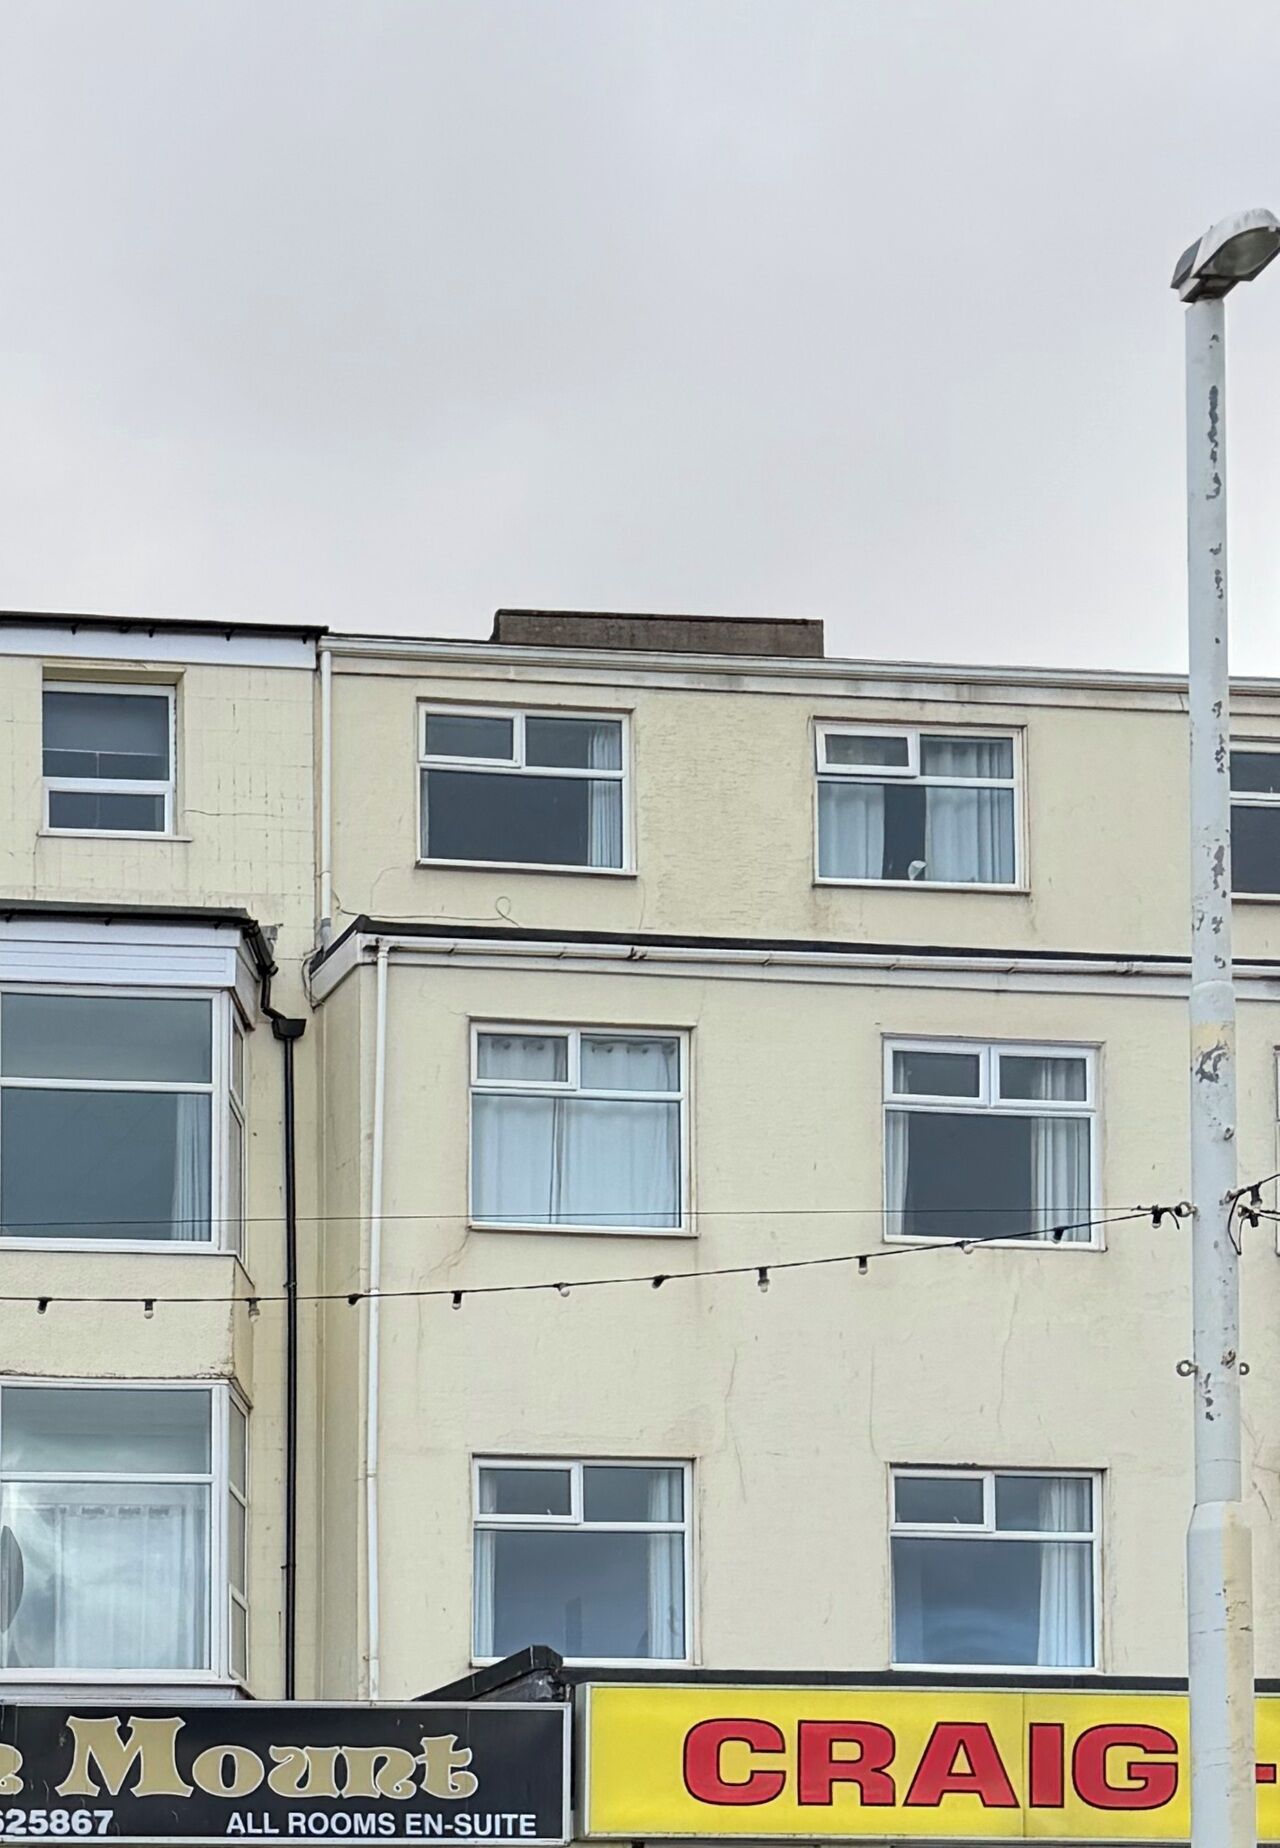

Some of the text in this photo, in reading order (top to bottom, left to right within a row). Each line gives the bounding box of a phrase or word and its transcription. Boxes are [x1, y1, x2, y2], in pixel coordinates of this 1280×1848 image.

[55, 1714, 479, 1799] Mount
[225, 1811, 537, 1837] ALL ROOMS EN-SUITE
